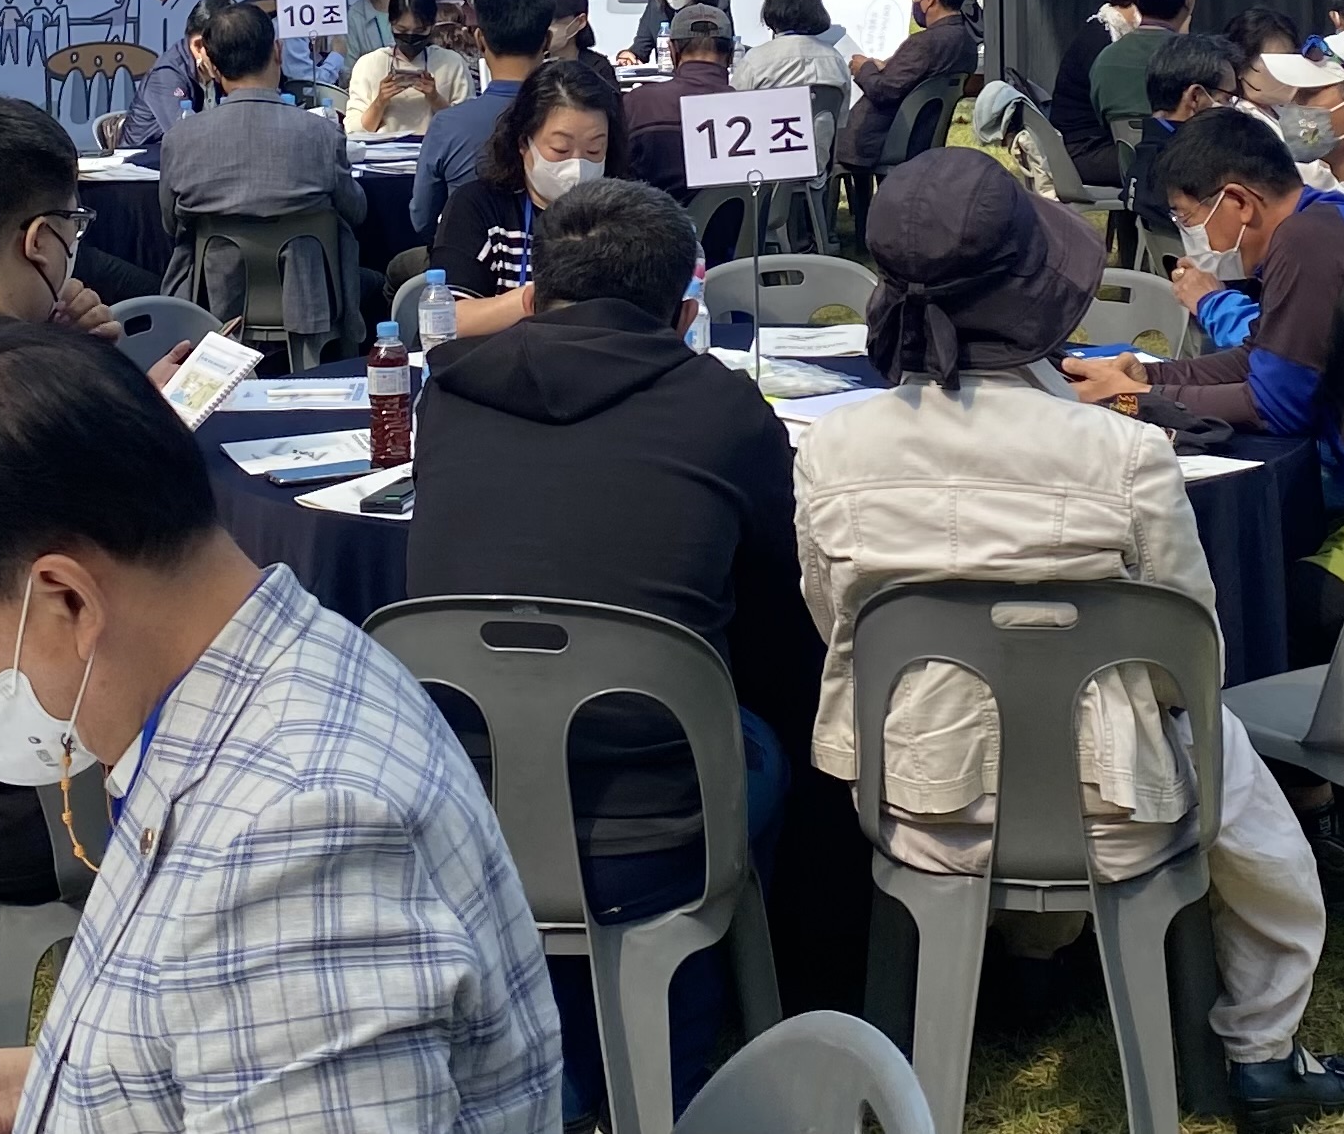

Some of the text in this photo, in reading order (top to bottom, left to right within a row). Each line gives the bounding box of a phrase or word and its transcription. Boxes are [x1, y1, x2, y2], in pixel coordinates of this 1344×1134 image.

[283, 4, 343, 27] 10 조
[695, 115, 809, 159] 12 조
